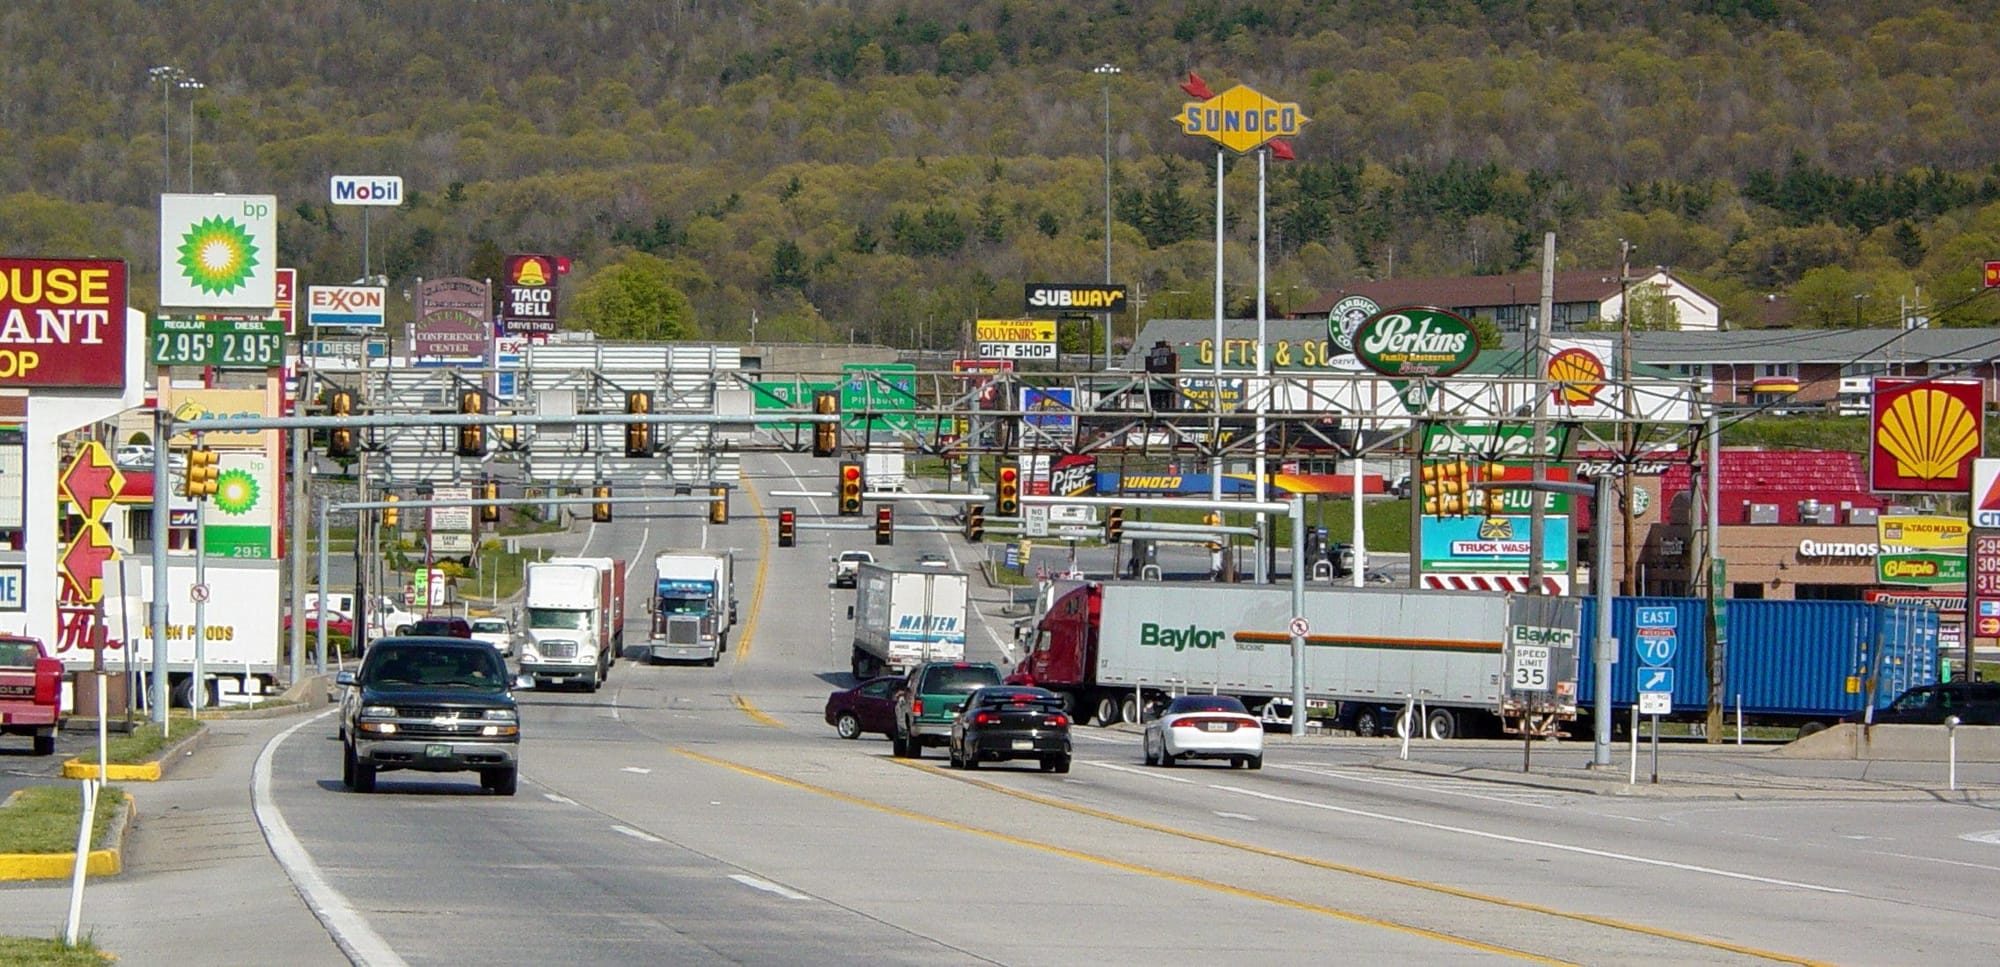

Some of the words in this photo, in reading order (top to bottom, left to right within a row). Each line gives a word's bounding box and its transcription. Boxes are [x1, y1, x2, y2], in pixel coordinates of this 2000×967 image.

[1187, 107, 1295, 132] SUNOCO
[336, 181, 398, 199] Mobil
[243, 202, 268, 221] bp
[0, 268, 110, 305] USE
[312, 289, 381, 312] EXXON
[511, 288, 552, 302] TACO
[1028, 289, 1124, 307] SUBWAY
[511, 303, 550, 316] BELL
[164, 321, 205, 329] REGULAR
[234, 321, 266, 330] DIESEL
[507, 322, 531, 330] DRIVE
[417, 332, 482, 341] CONFERENCE
[977, 328, 1037, 341] SOUVENIRS
[1364, 314, 1468, 354] Perkins
[430, 343, 469, 352] CENTER
[980, 344, 1010, 356] GIFT
[1015, 345, 1051, 356] SHOP
[1276, 341, 1290, 366] &
[1060, 476, 1091, 496] Hut
[1117, 476, 1182, 488] SUNOCO
[1459, 544, 1498, 552] TRUCK
[1643, 612, 1670, 623] EAST
[1141, 623, 1225, 651] Baylor
[1517, 627, 1571, 643] Baylor
[1517, 650, 1547, 658] SPEED
[1644, 640, 1669, 658] 70
[1517, 668, 1544, 685] 35
